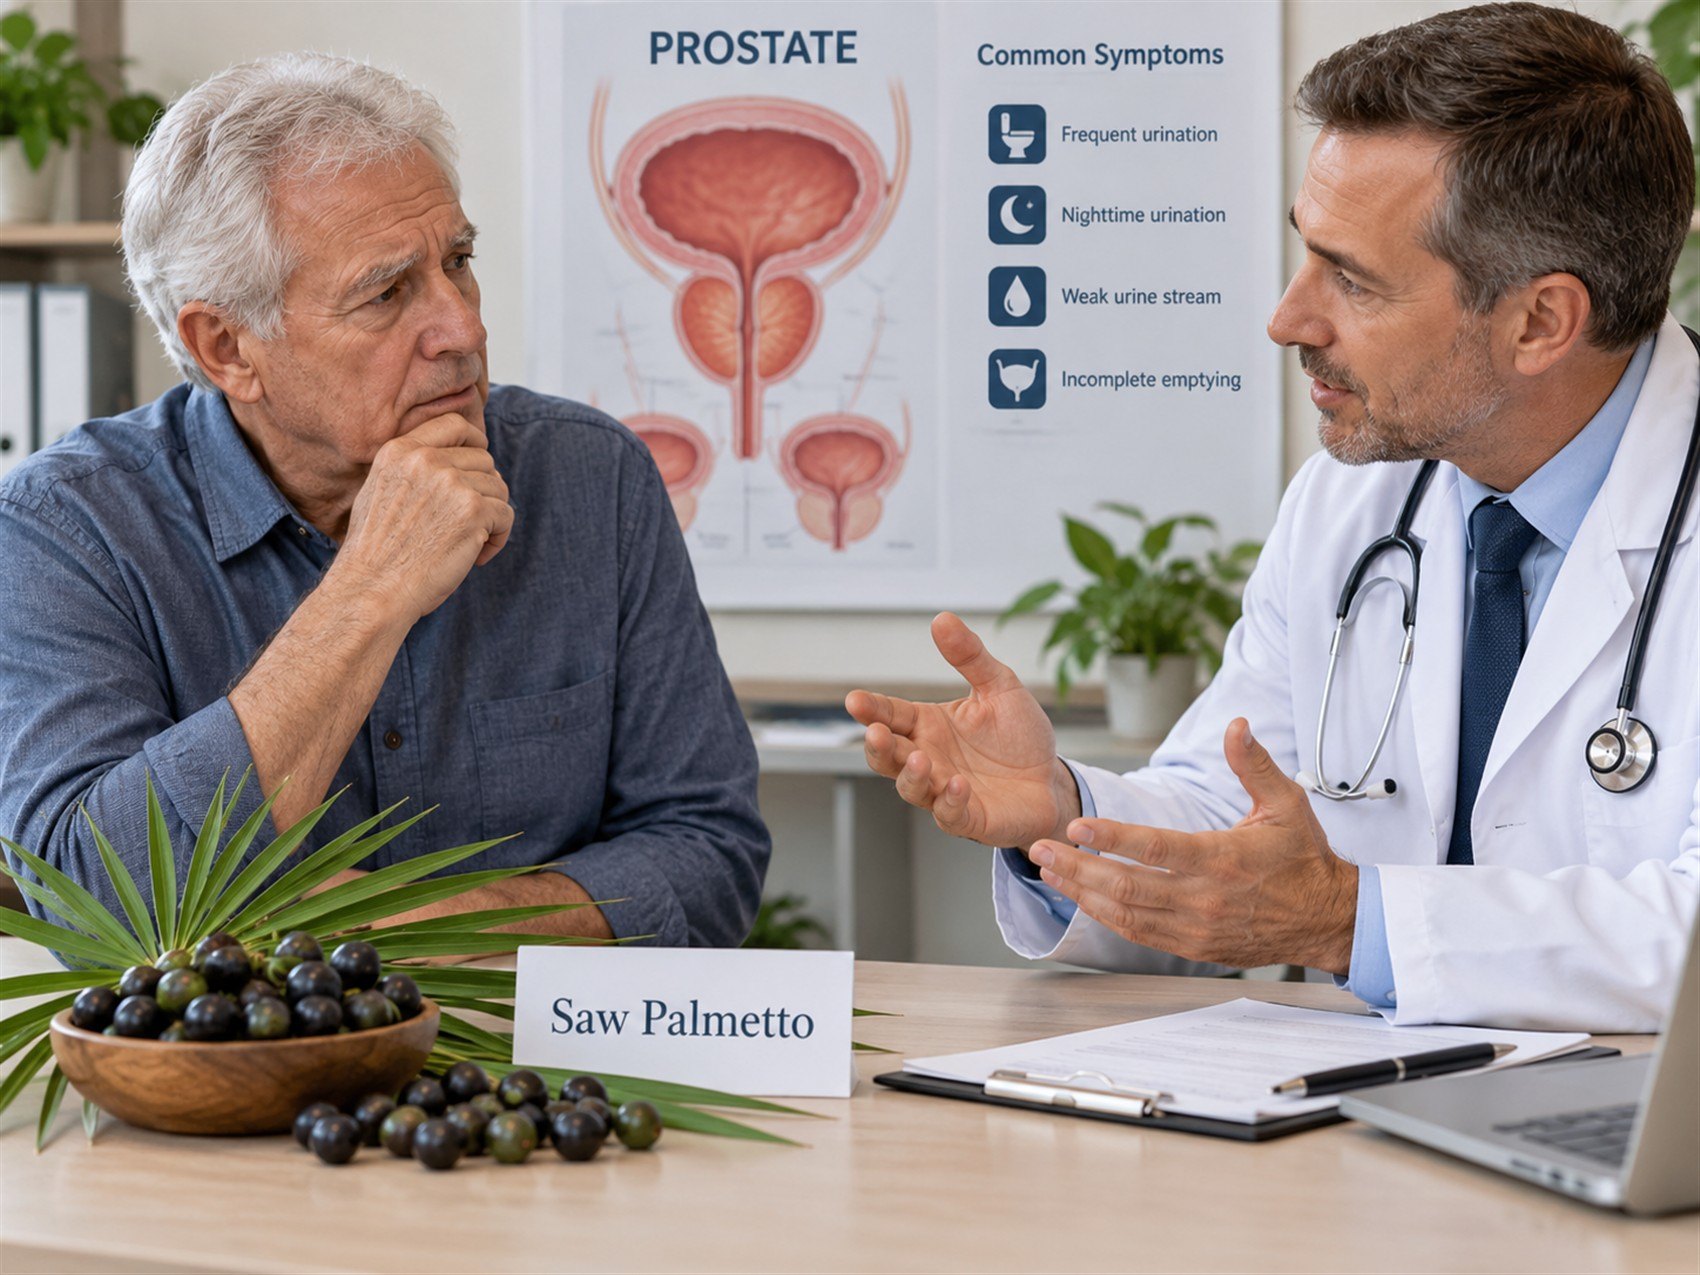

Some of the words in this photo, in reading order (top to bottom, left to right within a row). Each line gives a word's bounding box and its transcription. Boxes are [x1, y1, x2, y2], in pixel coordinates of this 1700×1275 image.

[650, 30, 858, 66] PROSTATE
[977, 43, 1086, 66] Common
[1094, 42, 1224, 71] Symptoms
[1062, 125, 1138, 147] Frequent
[1142, 125, 1218, 143] urination
[1062, 206, 1145, 228] Nighttime
[1150, 206, 1226, 223] urination
[1061, 287, 1109, 305] Weak
[1114, 288, 1158, 305] urine
[1163, 289, 1222, 305] stream
[1062, 370, 1157, 392] Incomplete
[1161, 370, 1242, 392] emptying
[551, 997, 630, 1035] Saw
[641, 999, 815, 1040] Palmetto
